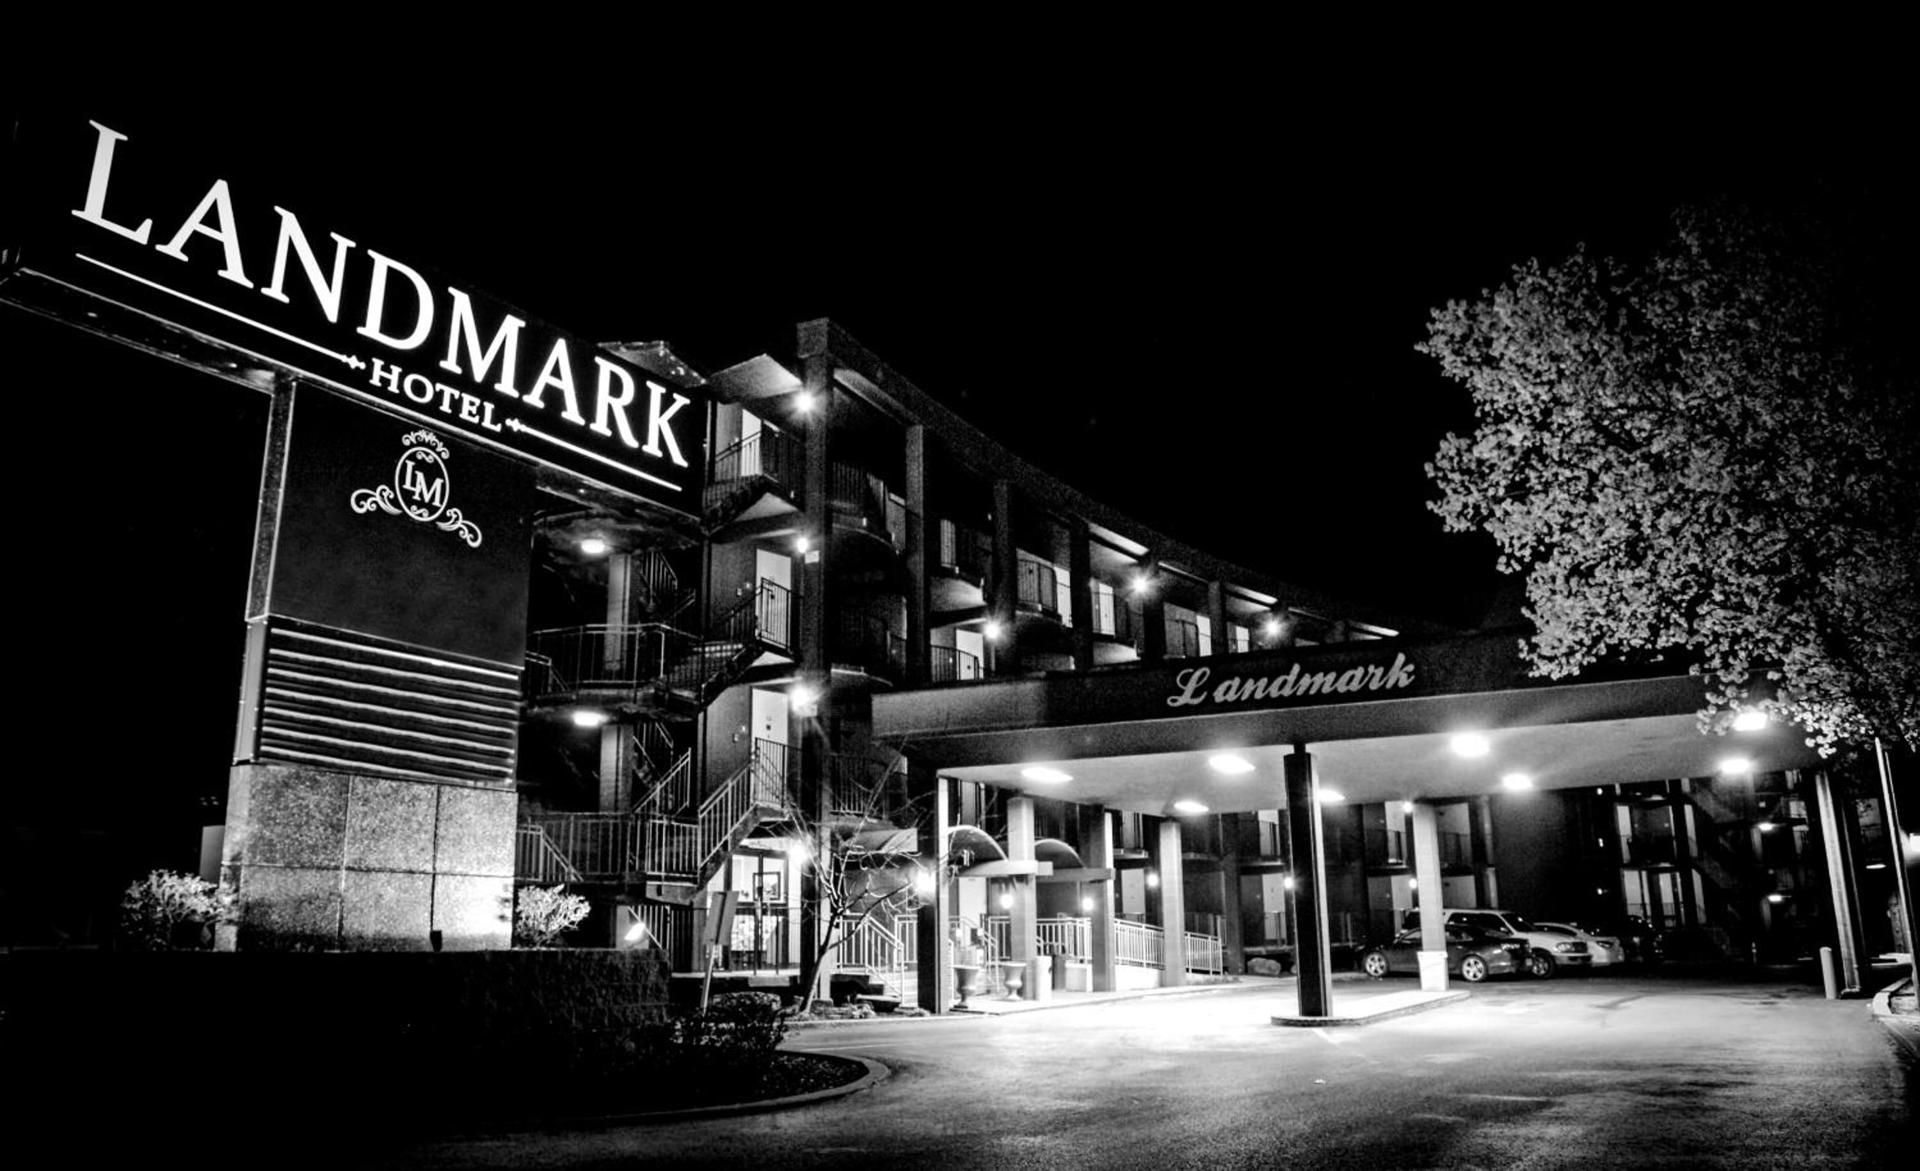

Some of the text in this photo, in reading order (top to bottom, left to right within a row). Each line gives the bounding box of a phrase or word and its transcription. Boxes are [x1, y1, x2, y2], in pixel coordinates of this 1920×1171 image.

[71, 119, 691, 468] LANDMARK
[369, 357, 502, 432] HOTEL
[402, 459, 444, 508] LM
[1167, 652, 1415, 707] Landmark
